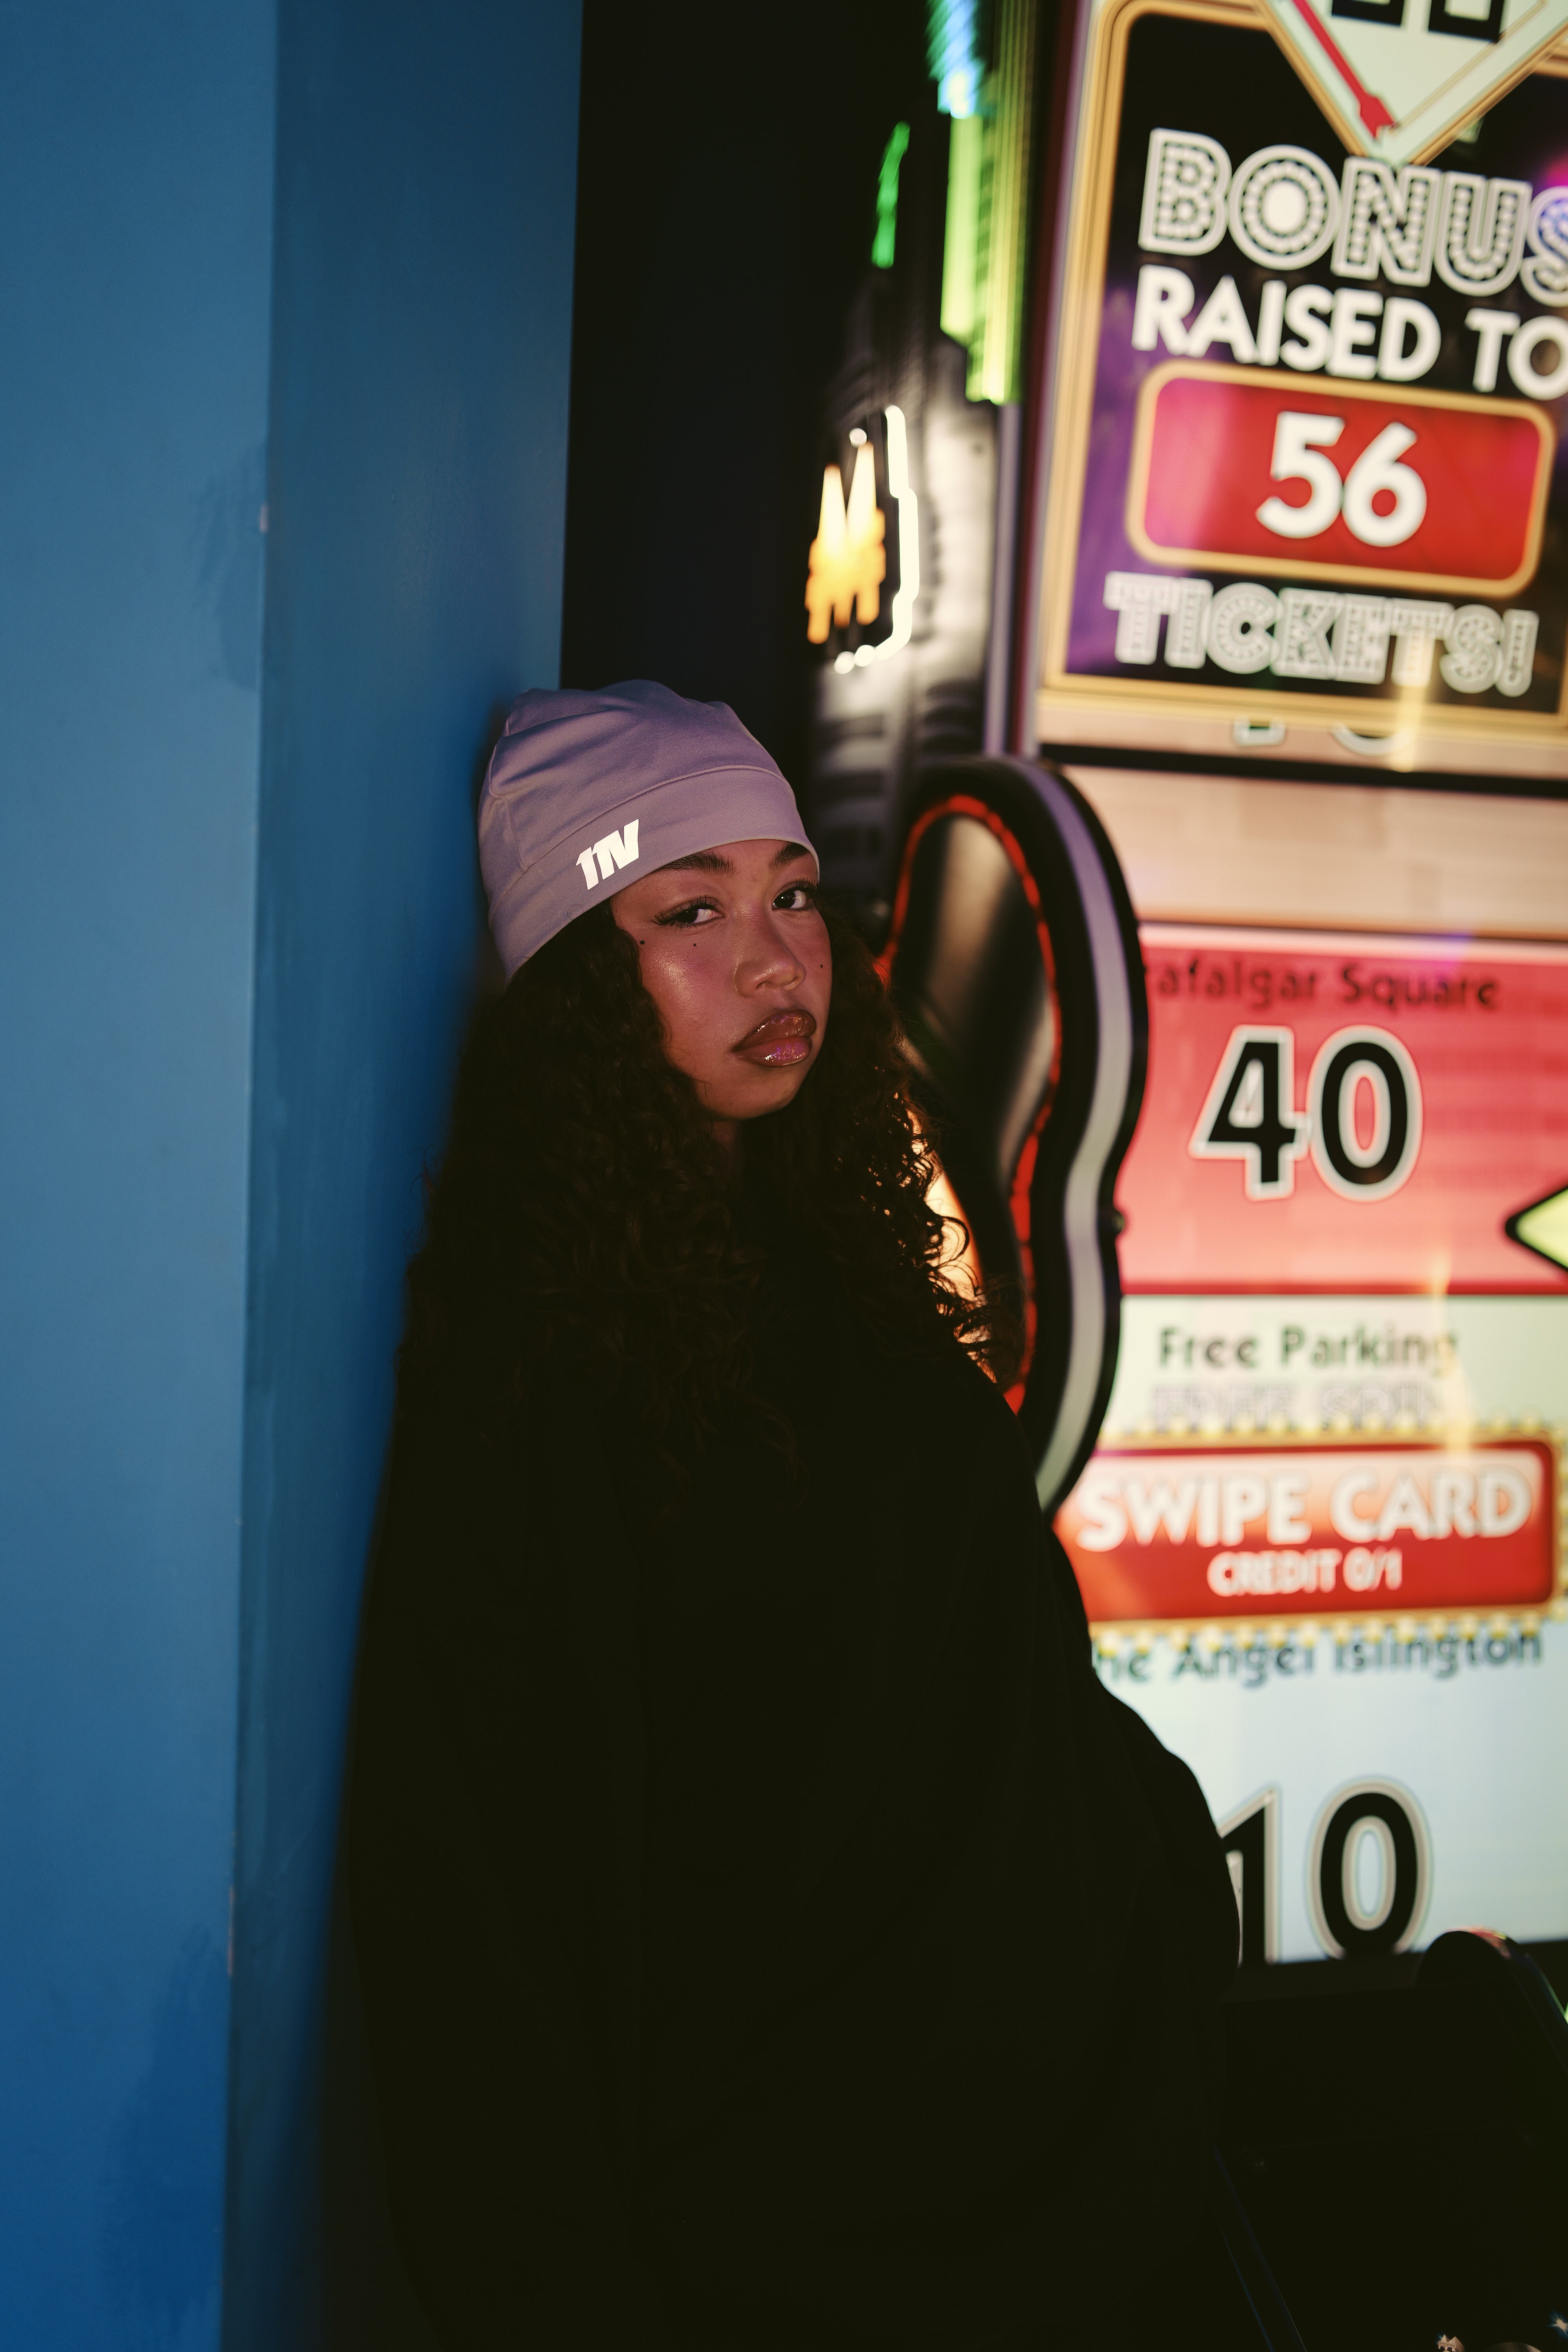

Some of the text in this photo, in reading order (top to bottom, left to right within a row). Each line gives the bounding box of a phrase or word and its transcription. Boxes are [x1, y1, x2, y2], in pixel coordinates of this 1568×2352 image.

[1138, 127, 1568, 307] BONUS
[1131, 263, 1568, 400] RAISED TO
[1256, 410, 1428, 548] 56
[1102, 570, 1540, 698] TICKETS!
[1145, 956, 1501, 1012] afalgar Square
[1188, 1024, 1423, 1203] 40
[1158, 1324, 1258, 1369] Free
[1075, 1465, 1532, 1552] SWIPE CARD
[1207, 1548, 1343, 1597] CREDIT
[1217, 1782, 1433, 1964] 10
